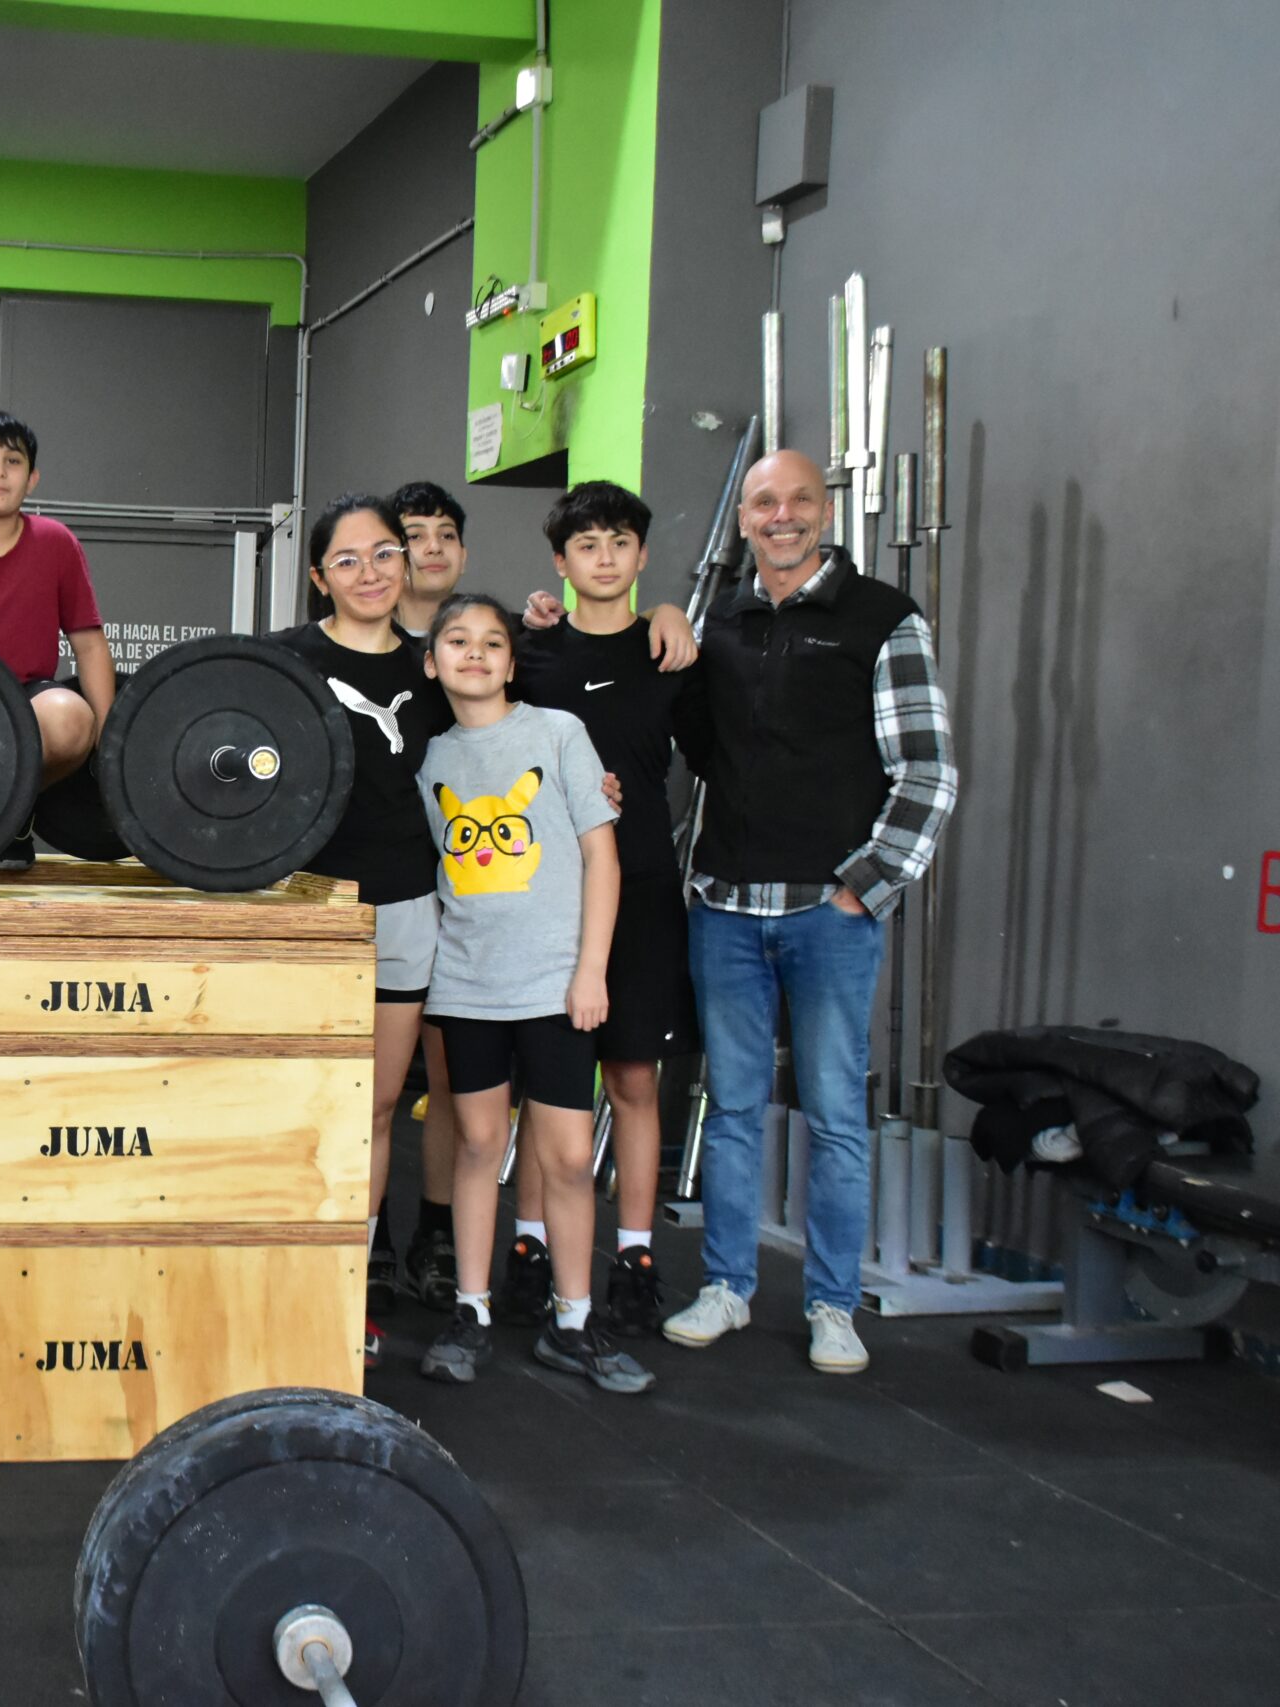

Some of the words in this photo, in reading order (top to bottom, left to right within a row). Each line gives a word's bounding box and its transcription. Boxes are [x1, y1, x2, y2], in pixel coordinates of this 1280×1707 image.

[123, 623, 160, 641] HACIA
[163, 625, 178, 642] EL
[126, 643, 143, 659] DE
[40, 981, 154, 1012] JUMA
[40, 1126, 153, 1157] JUMA
[35, 1340, 149, 1371] JUMA
